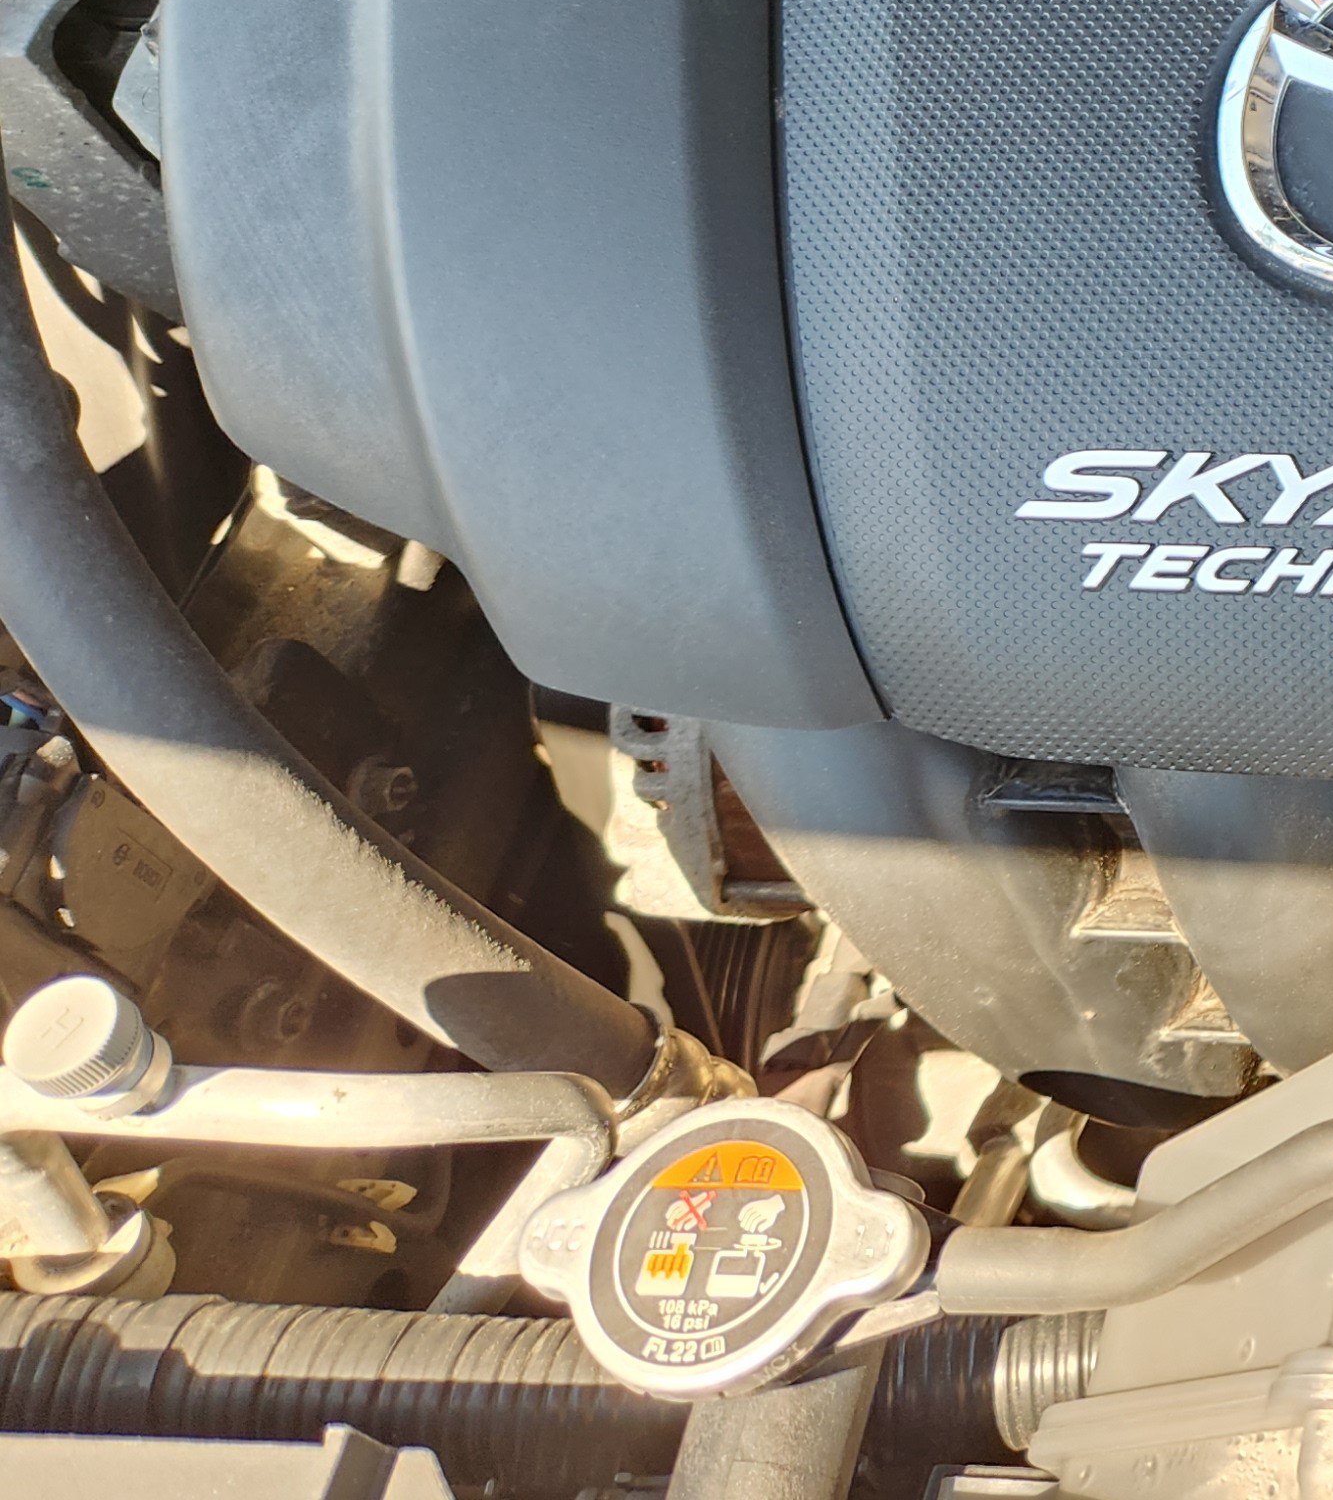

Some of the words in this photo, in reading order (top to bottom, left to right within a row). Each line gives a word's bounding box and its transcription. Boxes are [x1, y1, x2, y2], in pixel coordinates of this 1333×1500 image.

[658, 1299, 686, 1315] 108
[687, 1299, 719, 1316] kPa
[683, 1315, 711, 1333] psi
[641, 1336, 698, 1363] FL22
